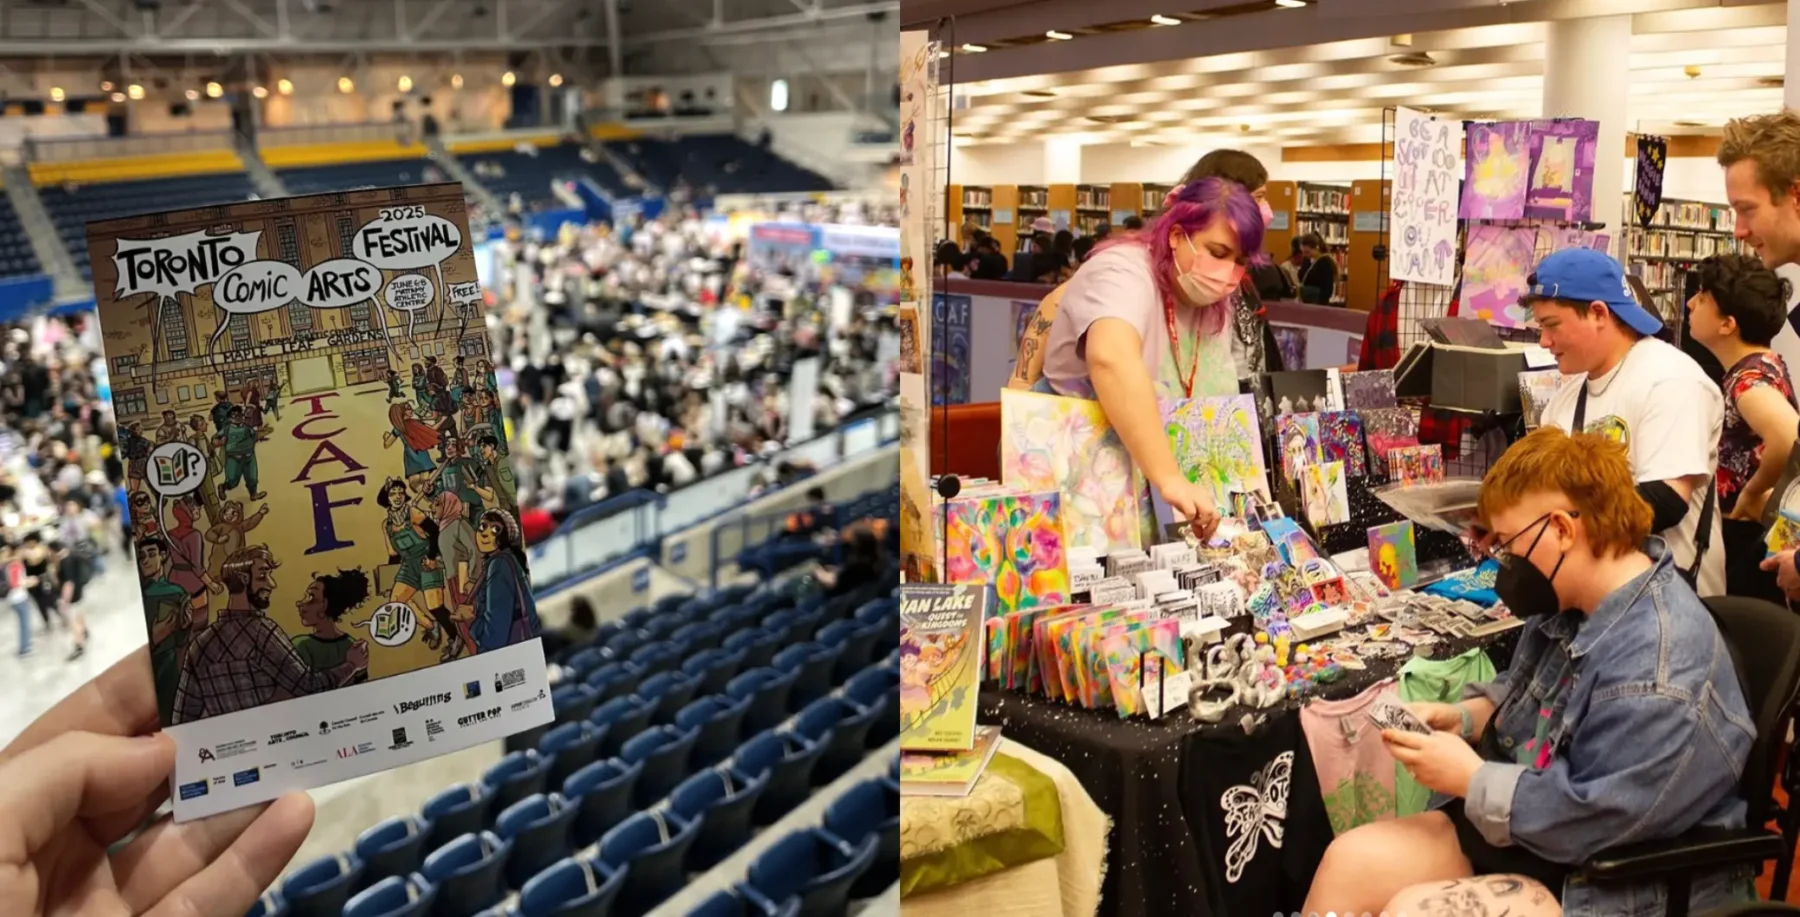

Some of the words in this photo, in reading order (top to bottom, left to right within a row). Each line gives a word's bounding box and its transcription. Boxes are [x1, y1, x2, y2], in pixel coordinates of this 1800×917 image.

[1409, 118, 1432, 141] BE
[380, 206, 424, 222] 2025
[363, 223, 458, 258] FESTIVAL
[117, 237, 244, 290] TORONTO
[307, 267, 371, 301] ARTS
[391, 280, 412, 290] JUNE
[452, 283, 480, 298] FREE!
[224, 346, 268, 362] MAPLE
[282, 339, 314, 354] LEAF
[328, 328, 384, 346] GARDENS
[932, 594, 976, 612] LAKE
[921, 619, 967, 629] KINGDOMS
[928, 611, 957, 621] QUEST
[457, 711, 485, 726] GUTTER
[487, 706, 502, 717] POP
